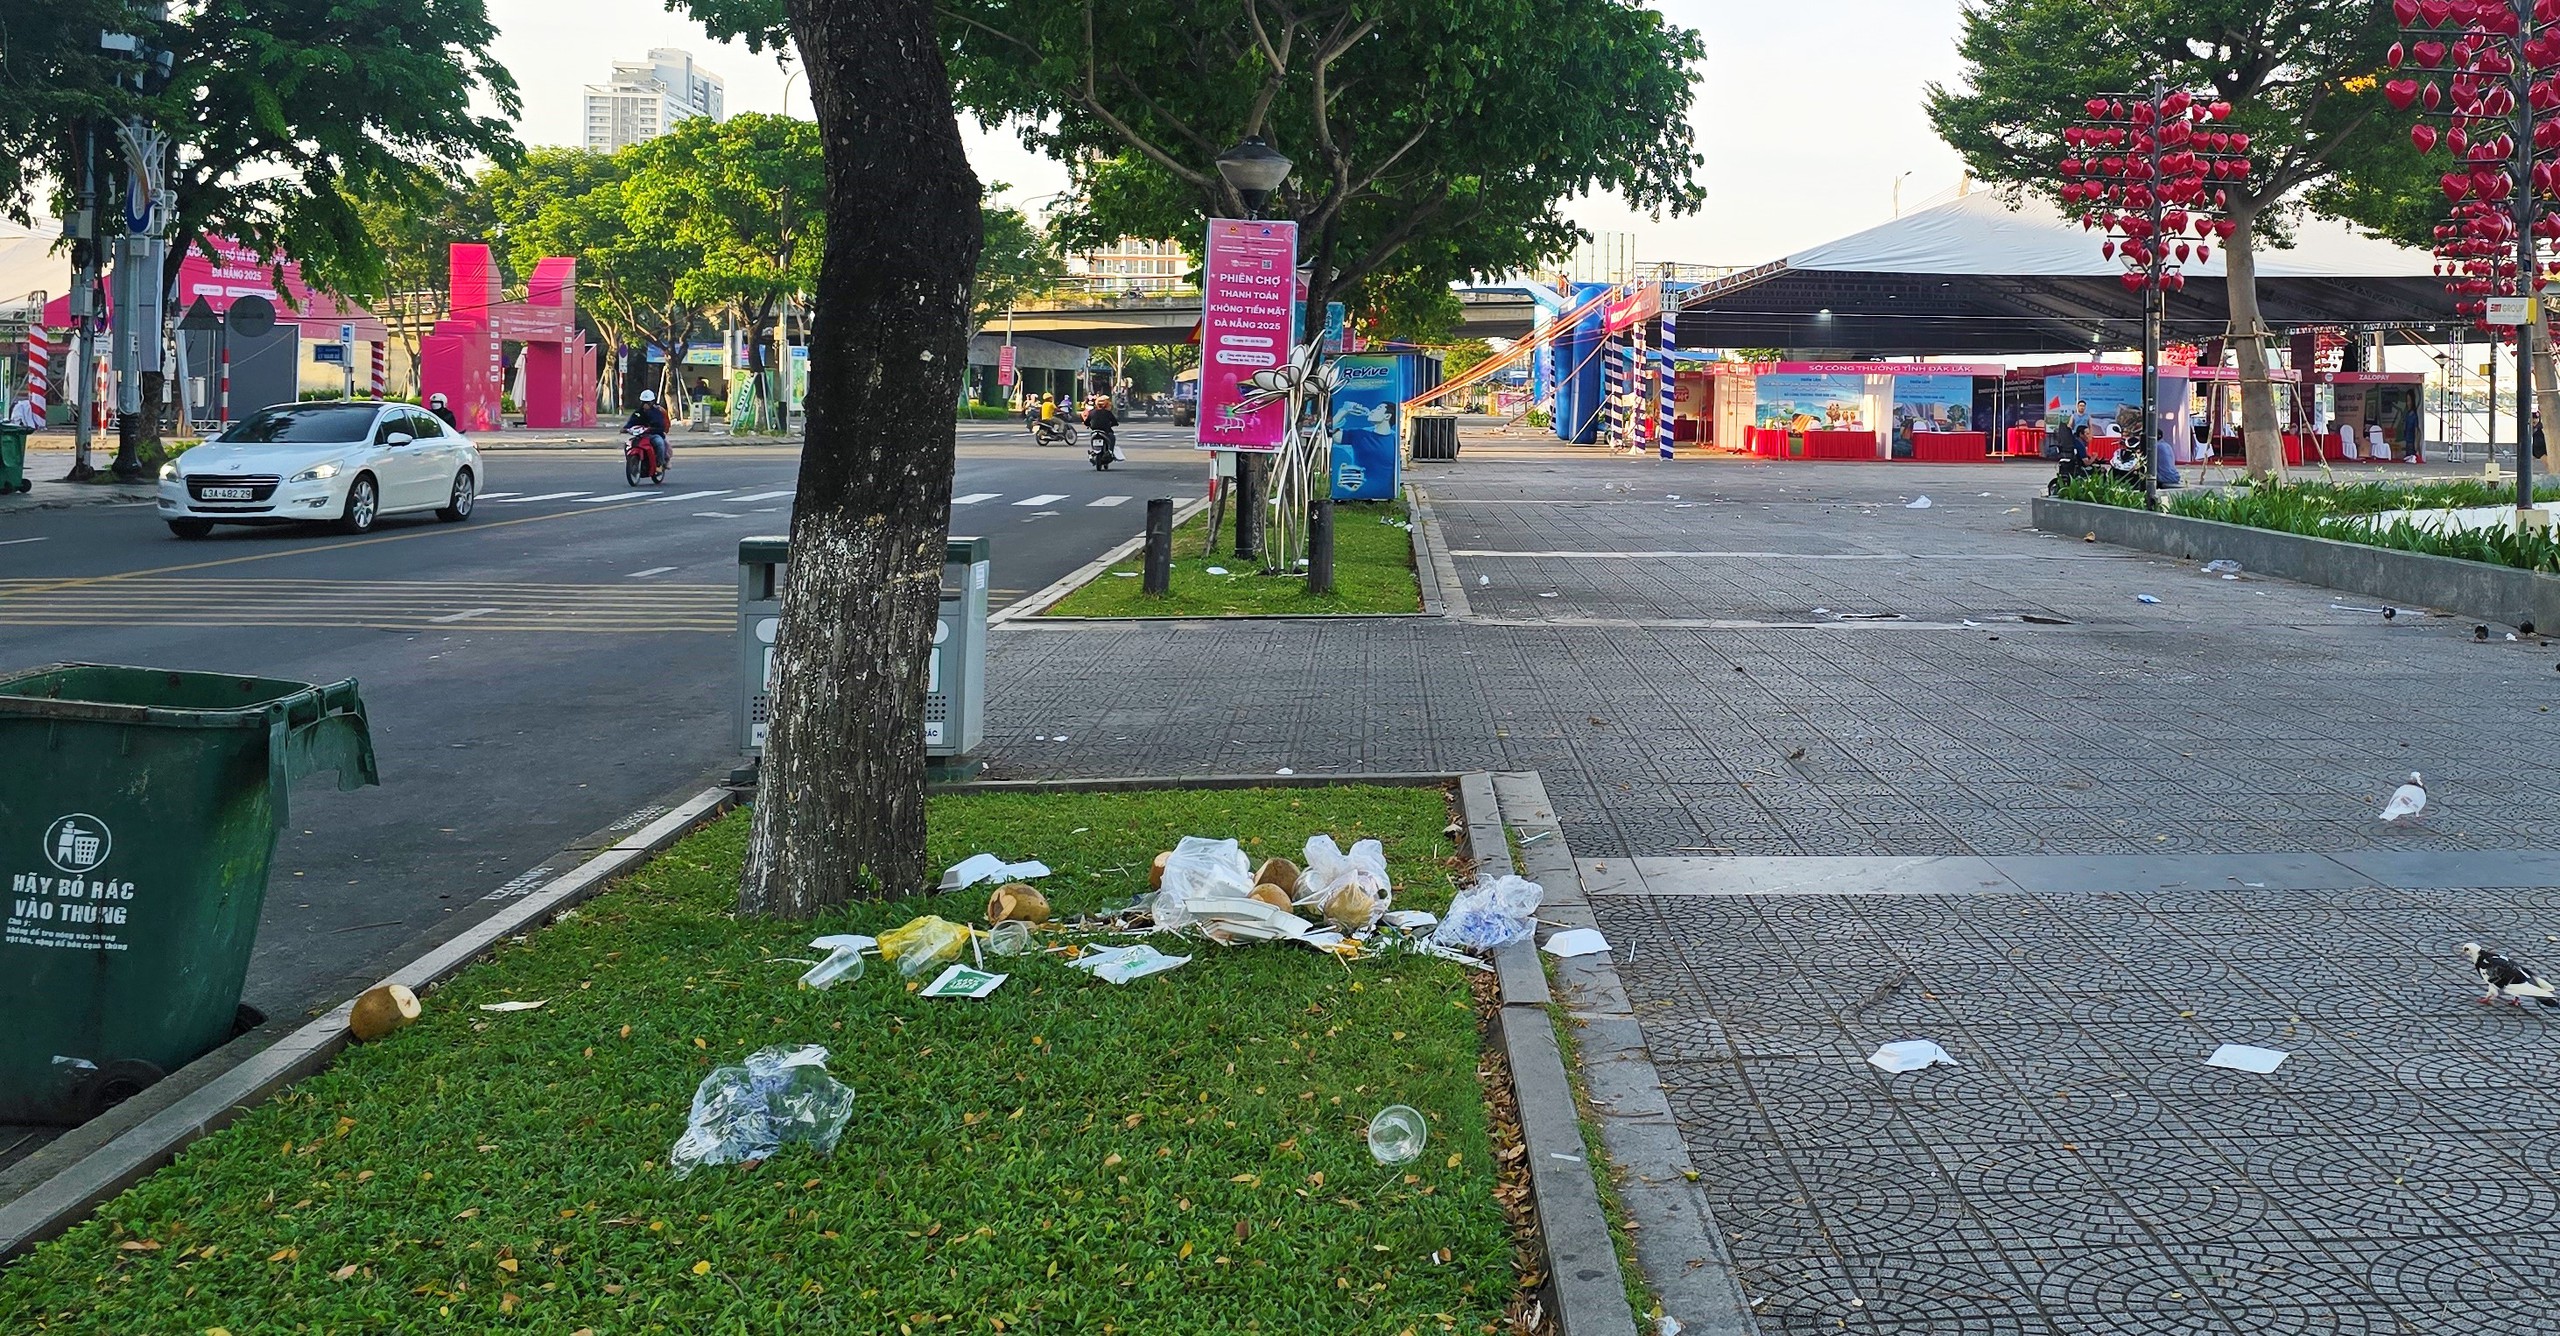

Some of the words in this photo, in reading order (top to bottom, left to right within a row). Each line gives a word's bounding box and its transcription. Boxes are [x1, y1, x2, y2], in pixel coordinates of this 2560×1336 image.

[244, 270, 262, 281] 2025
[1219, 272, 1253, 284] PHIÊN
[1255, 275, 1281, 288] CHỢ
[1219, 289, 1252, 299] THANH
[1253, 290, 1279, 300] TOÁN
[1210, 303, 1243, 313] KHÔNG
[1266, 306, 1287, 317] MẶT
[2502, 304, 2524, 313] GROUP
[1214, 318, 1228, 328] ĐÀ
[1229, 317, 1256, 329] NẴNG
[1257, 322, 1281, 330] 2025
[1808, 364, 1823, 372] SỞ
[1825, 364, 1855, 372] CÔNG
[1856, 364, 1903, 373] THƯƠNG
[12, 871, 53, 895] HÃY
[57, 873, 85, 898] BỎ
[90, 878, 135, 900] RÁC
[15, 896, 54, 919] VÀO
[60, 901, 127, 924] THÙNG
[41, 929, 54, 938] tro
